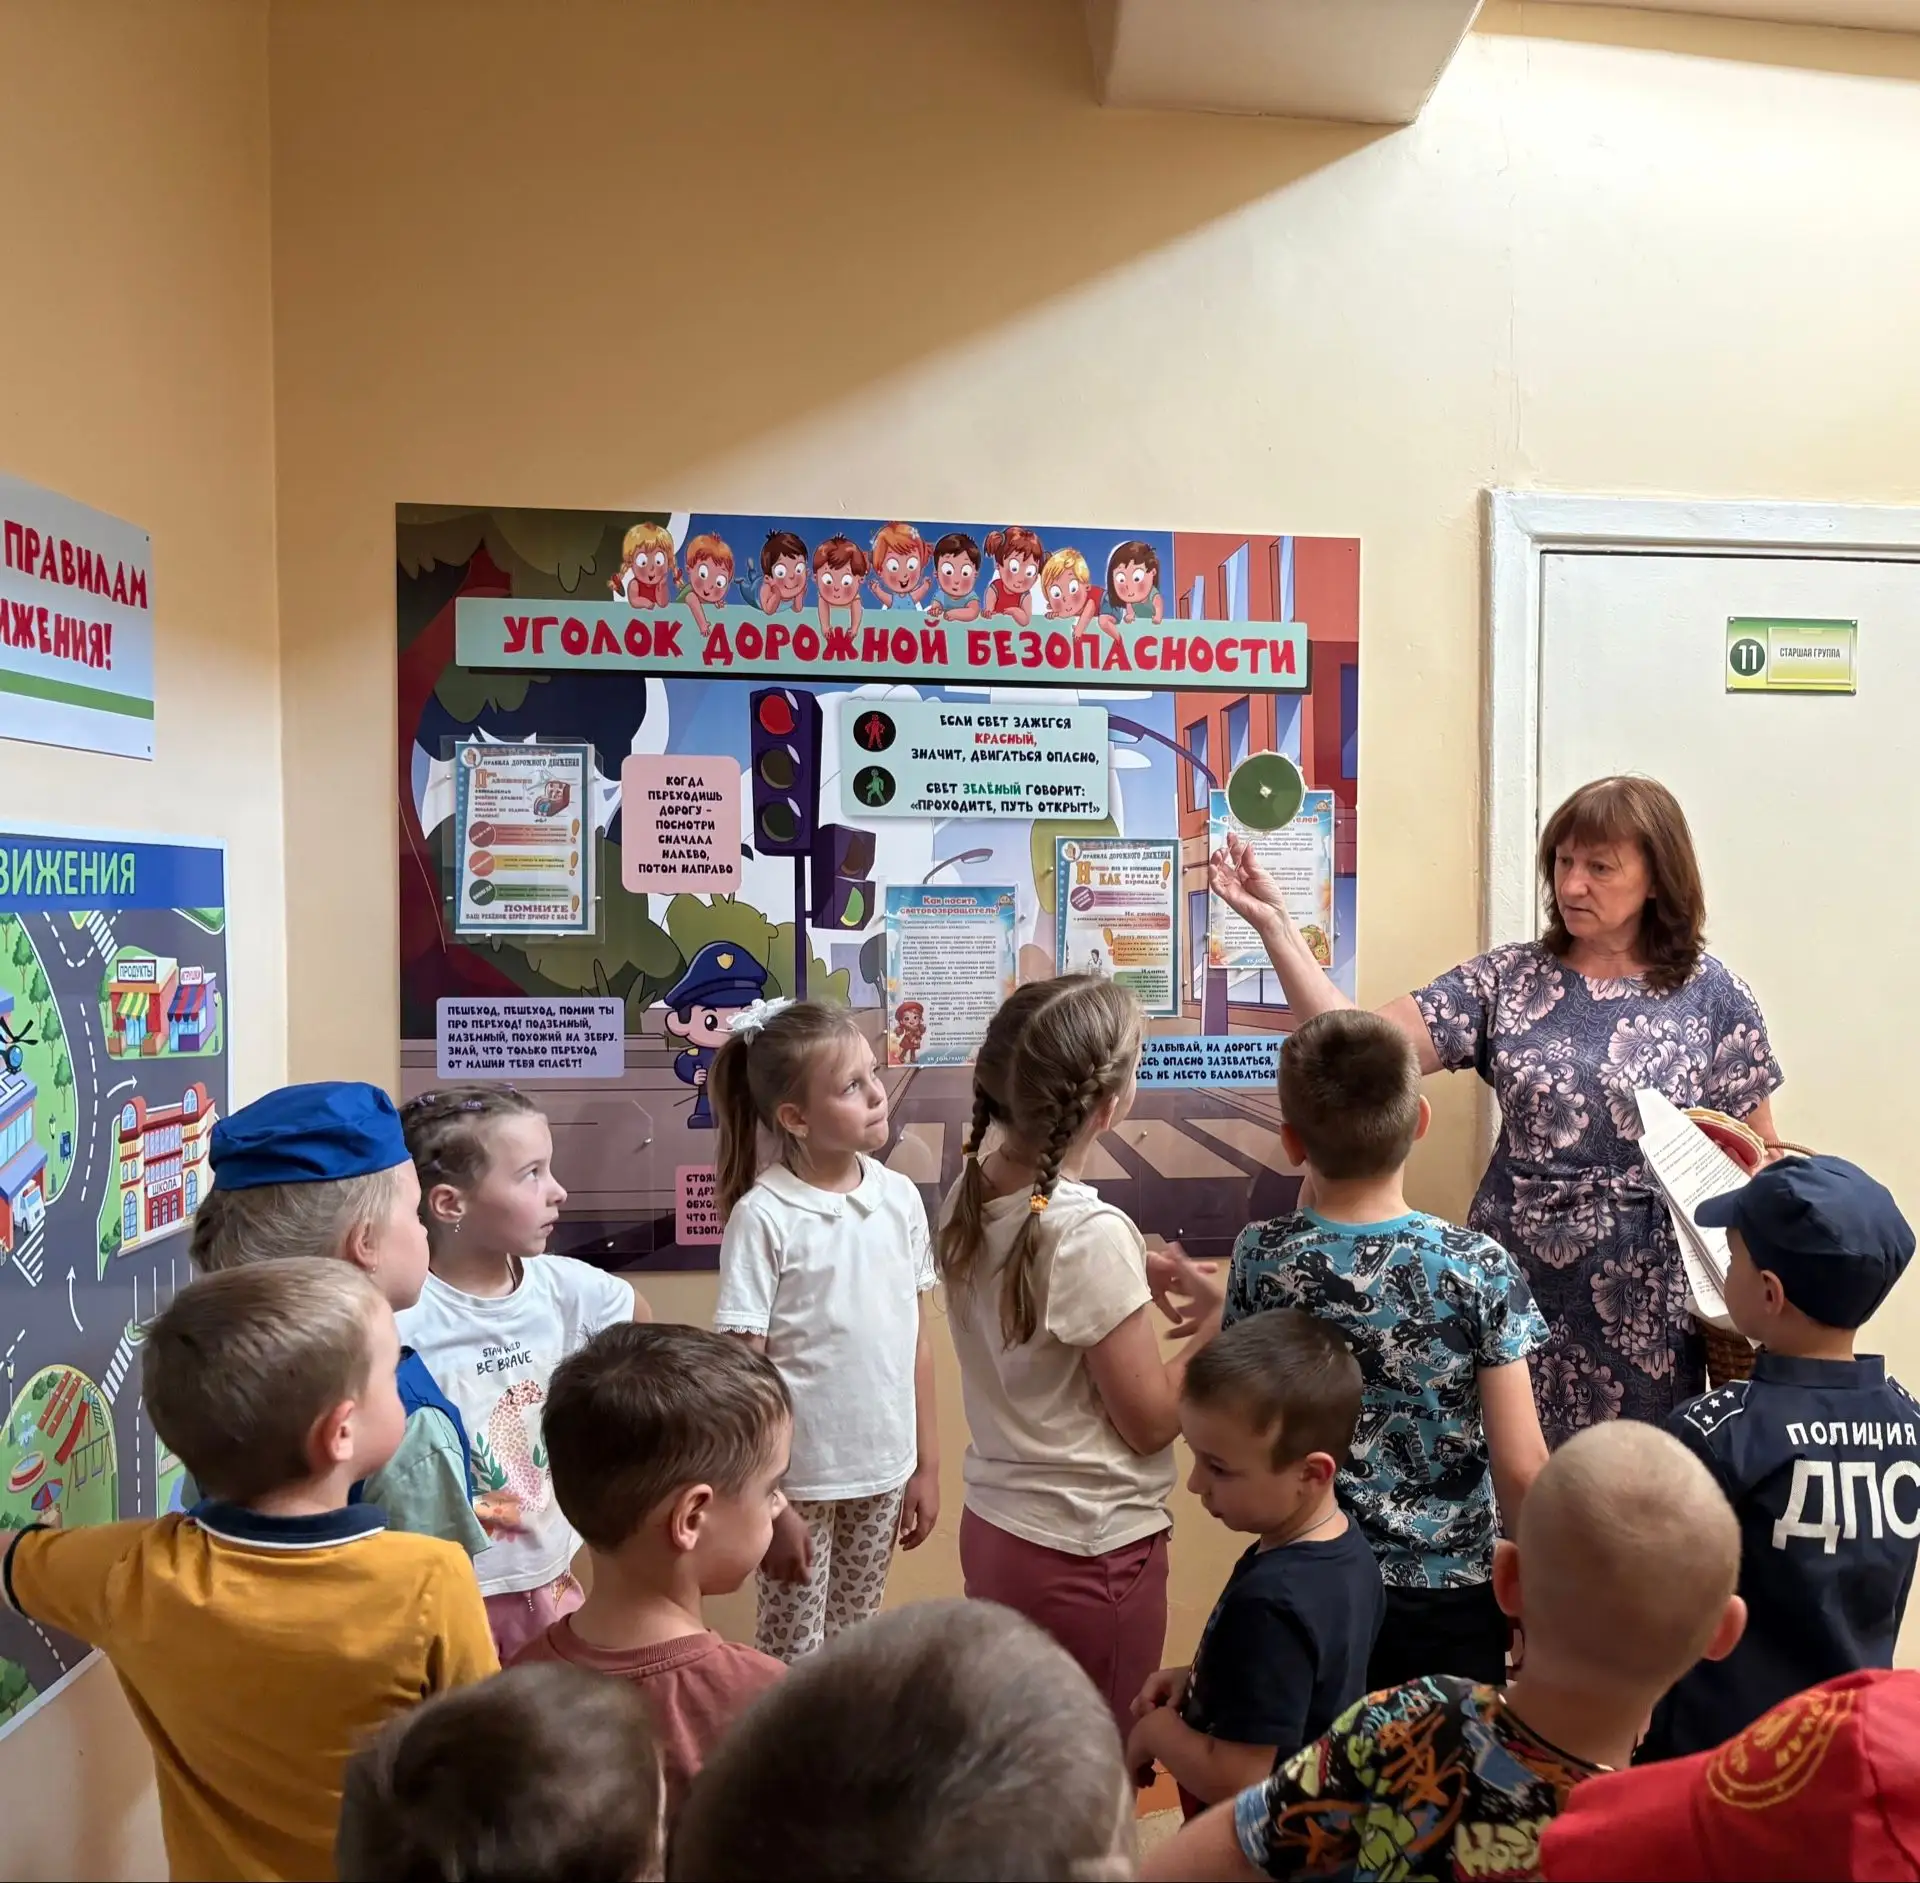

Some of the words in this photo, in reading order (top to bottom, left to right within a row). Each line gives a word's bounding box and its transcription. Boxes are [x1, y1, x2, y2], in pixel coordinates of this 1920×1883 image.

[4, 519, 148, 609] ПРАВИЛАМ
[503, 615, 683, 659] УГОЛОК
[702, 619, 949, 666] ДОРОЖНОЙ
[967, 629, 1297, 675] БЕЗОПАСНОСТИ
[1738, 645, 1757, 670] 11
[1780, 647, 1813, 658] СТАРШАЯ
[1814, 648, 1841, 659] ГРУППА
[940, 714, 973, 727] ЕСЛИ
[977, 716, 1009, 728] СВЕТ
[1013, 717, 1072, 729] ЗАЖЕГСЯ
[974, 732, 1038, 747] КРАСНЫЙ,
[911, 748, 966, 763] ЗНАЧИТ,
[970, 750, 1042, 763] ДВИГАТЬСЯ
[1046, 751, 1100, 765] ОПАСНО,
[666, 776, 704, 788] КОГДА
[926, 783, 958, 794] СВЕТ
[963, 781, 1022, 795] ЗЕЛЁНЫЙ
[1026, 784, 1085, 797] ГОВОРИТ:
[648, 790, 723, 802] ПЕРЕХОДИШЬ
[659, 805, 702, 817] ДОРОГУ
[910, 799, 997, 814] «ПРОХОДИТЕ,
[1001, 801, 1033, 813] ПУТЬ
[1038, 801, 1101, 814] ОТКРЫТ!»
[656, 820, 715, 830] ПОСМОТРИ
[658, 835, 713, 845] СНАЧАЛА
[662, 849, 710, 861] НАЛЕВО,
[638, 863, 677, 873] ПОТОМ
[682, 864, 733, 874] НАПРАВО
[1098, 872, 1122, 886] КАК
[922, 895, 942, 905] Как
[944, 896, 977, 905] носить
[504, 904, 569, 913] ПОМНИТЕ
[119, 964, 153, 978] ПРОДУКТЫ
[447, 1006, 501, 1017] ПЕШЕХОД,
[503, 1006, 556, 1017] ПЕШЕХОД,
[559, 1006, 595, 1016] ПОМНИ
[599, 1006, 615, 1015] ТЫ
[448, 1019, 468, 1029] ПРО
[471, 1019, 522, 1030] ПЕРЕХОД!
[525, 1018, 592, 1030] ПОДЗЕМНЫЙ,
[448, 1031, 508, 1043] НАЗЕМНЫЙ,
[512, 1031, 562, 1042] ПОХОЖИЙ
[565, 1033, 580, 1042] НА
[584, 1033, 618, 1042] ЗЕБРУ.
[448, 1045, 479, 1057] ЗНАЙ,
[482, 1046, 503, 1055] ЧТО
[507, 1046, 548, 1055] ТОЛЬКО
[550, 1046, 598, 1056] ПЕРЕХОД
[1152, 1042, 1203, 1053] ЗАБЫВАЙ,
[1206, 1043, 1221, 1052] НА
[1224, 1043, 1262, 1053] ДОРОГЕ
[448, 1059, 462, 1069] ОТ
[466, 1059, 505, 1069] МАШИН
[509, 1059, 535, 1069] ТЕБЯ
[538, 1058, 583, 1069] СПАСЁТ!
[1138, 1056, 1159, 1066] ЕСЬ
[1163, 1056, 1204, 1066] ОПАСНО
[1207, 1056, 1274, 1067] ЗАЗЕВАТЬСЯ,
[1136, 1070, 1153, 1080] ЕСЬ
[1157, 1070, 1170, 1080] НЕ
[1173, 1070, 1207, 1080] МЕСТО
[686, 1173, 715, 1182] СТОЯ
[152, 1180, 178, 1196] ШКОЛА
[686, 1187, 694, 1196] И
[686, 1200, 715, 1210] ОБХО
[686, 1213, 706, 1222] ЧТО
[482, 1347, 502, 1358] STAY
[476, 1359, 494, 1376] BE
[497, 1350, 533, 1372] BRAVE
[1786, 1421, 1917, 1451] ПОЛИЦИЯ
[1772, 1459, 1920, 1554] ДПС
